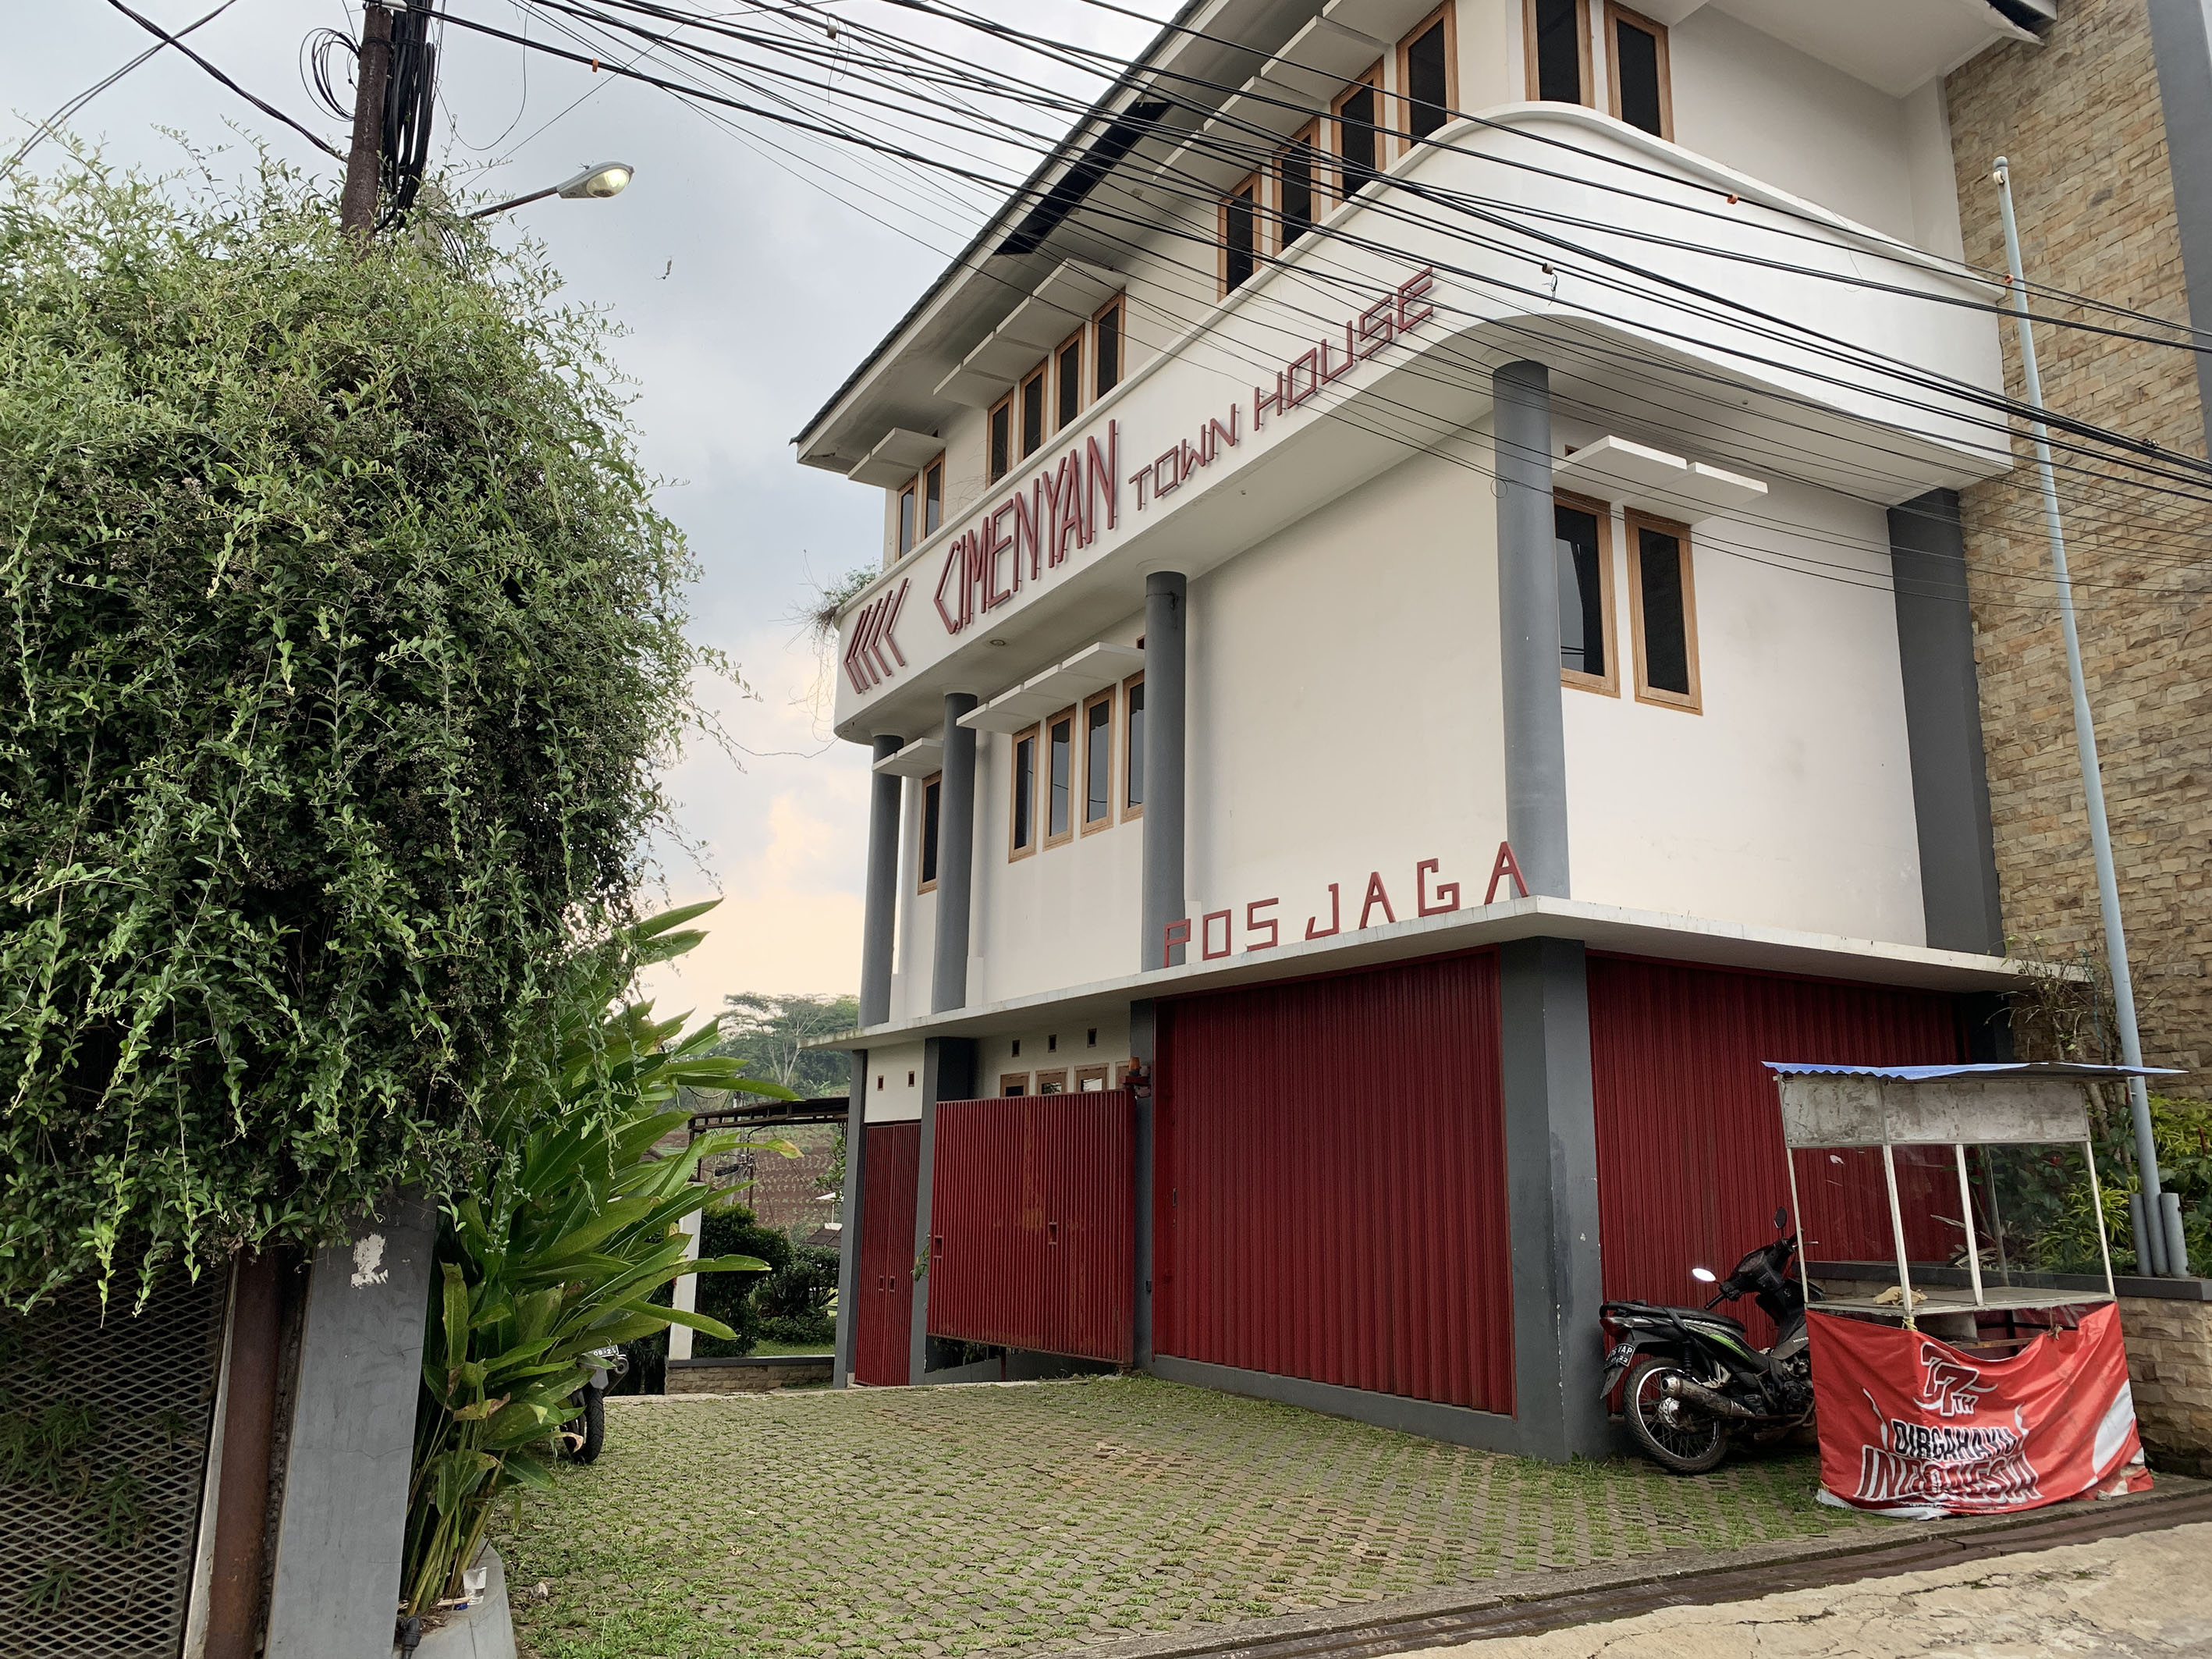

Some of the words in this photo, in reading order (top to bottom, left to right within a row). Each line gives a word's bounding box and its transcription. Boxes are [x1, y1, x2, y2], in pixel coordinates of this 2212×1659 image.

[933, 419, 1118, 635] CIMENYAN
[1128, 403, 1237, 511] TOWN
[1254, 265, 1435, 431] HOUSE
[1163, 897, 1279, 968] POS
[1305, 841, 1530, 940] JAGA
[1891, 1419, 2018, 1462] DIRGAHAYU
